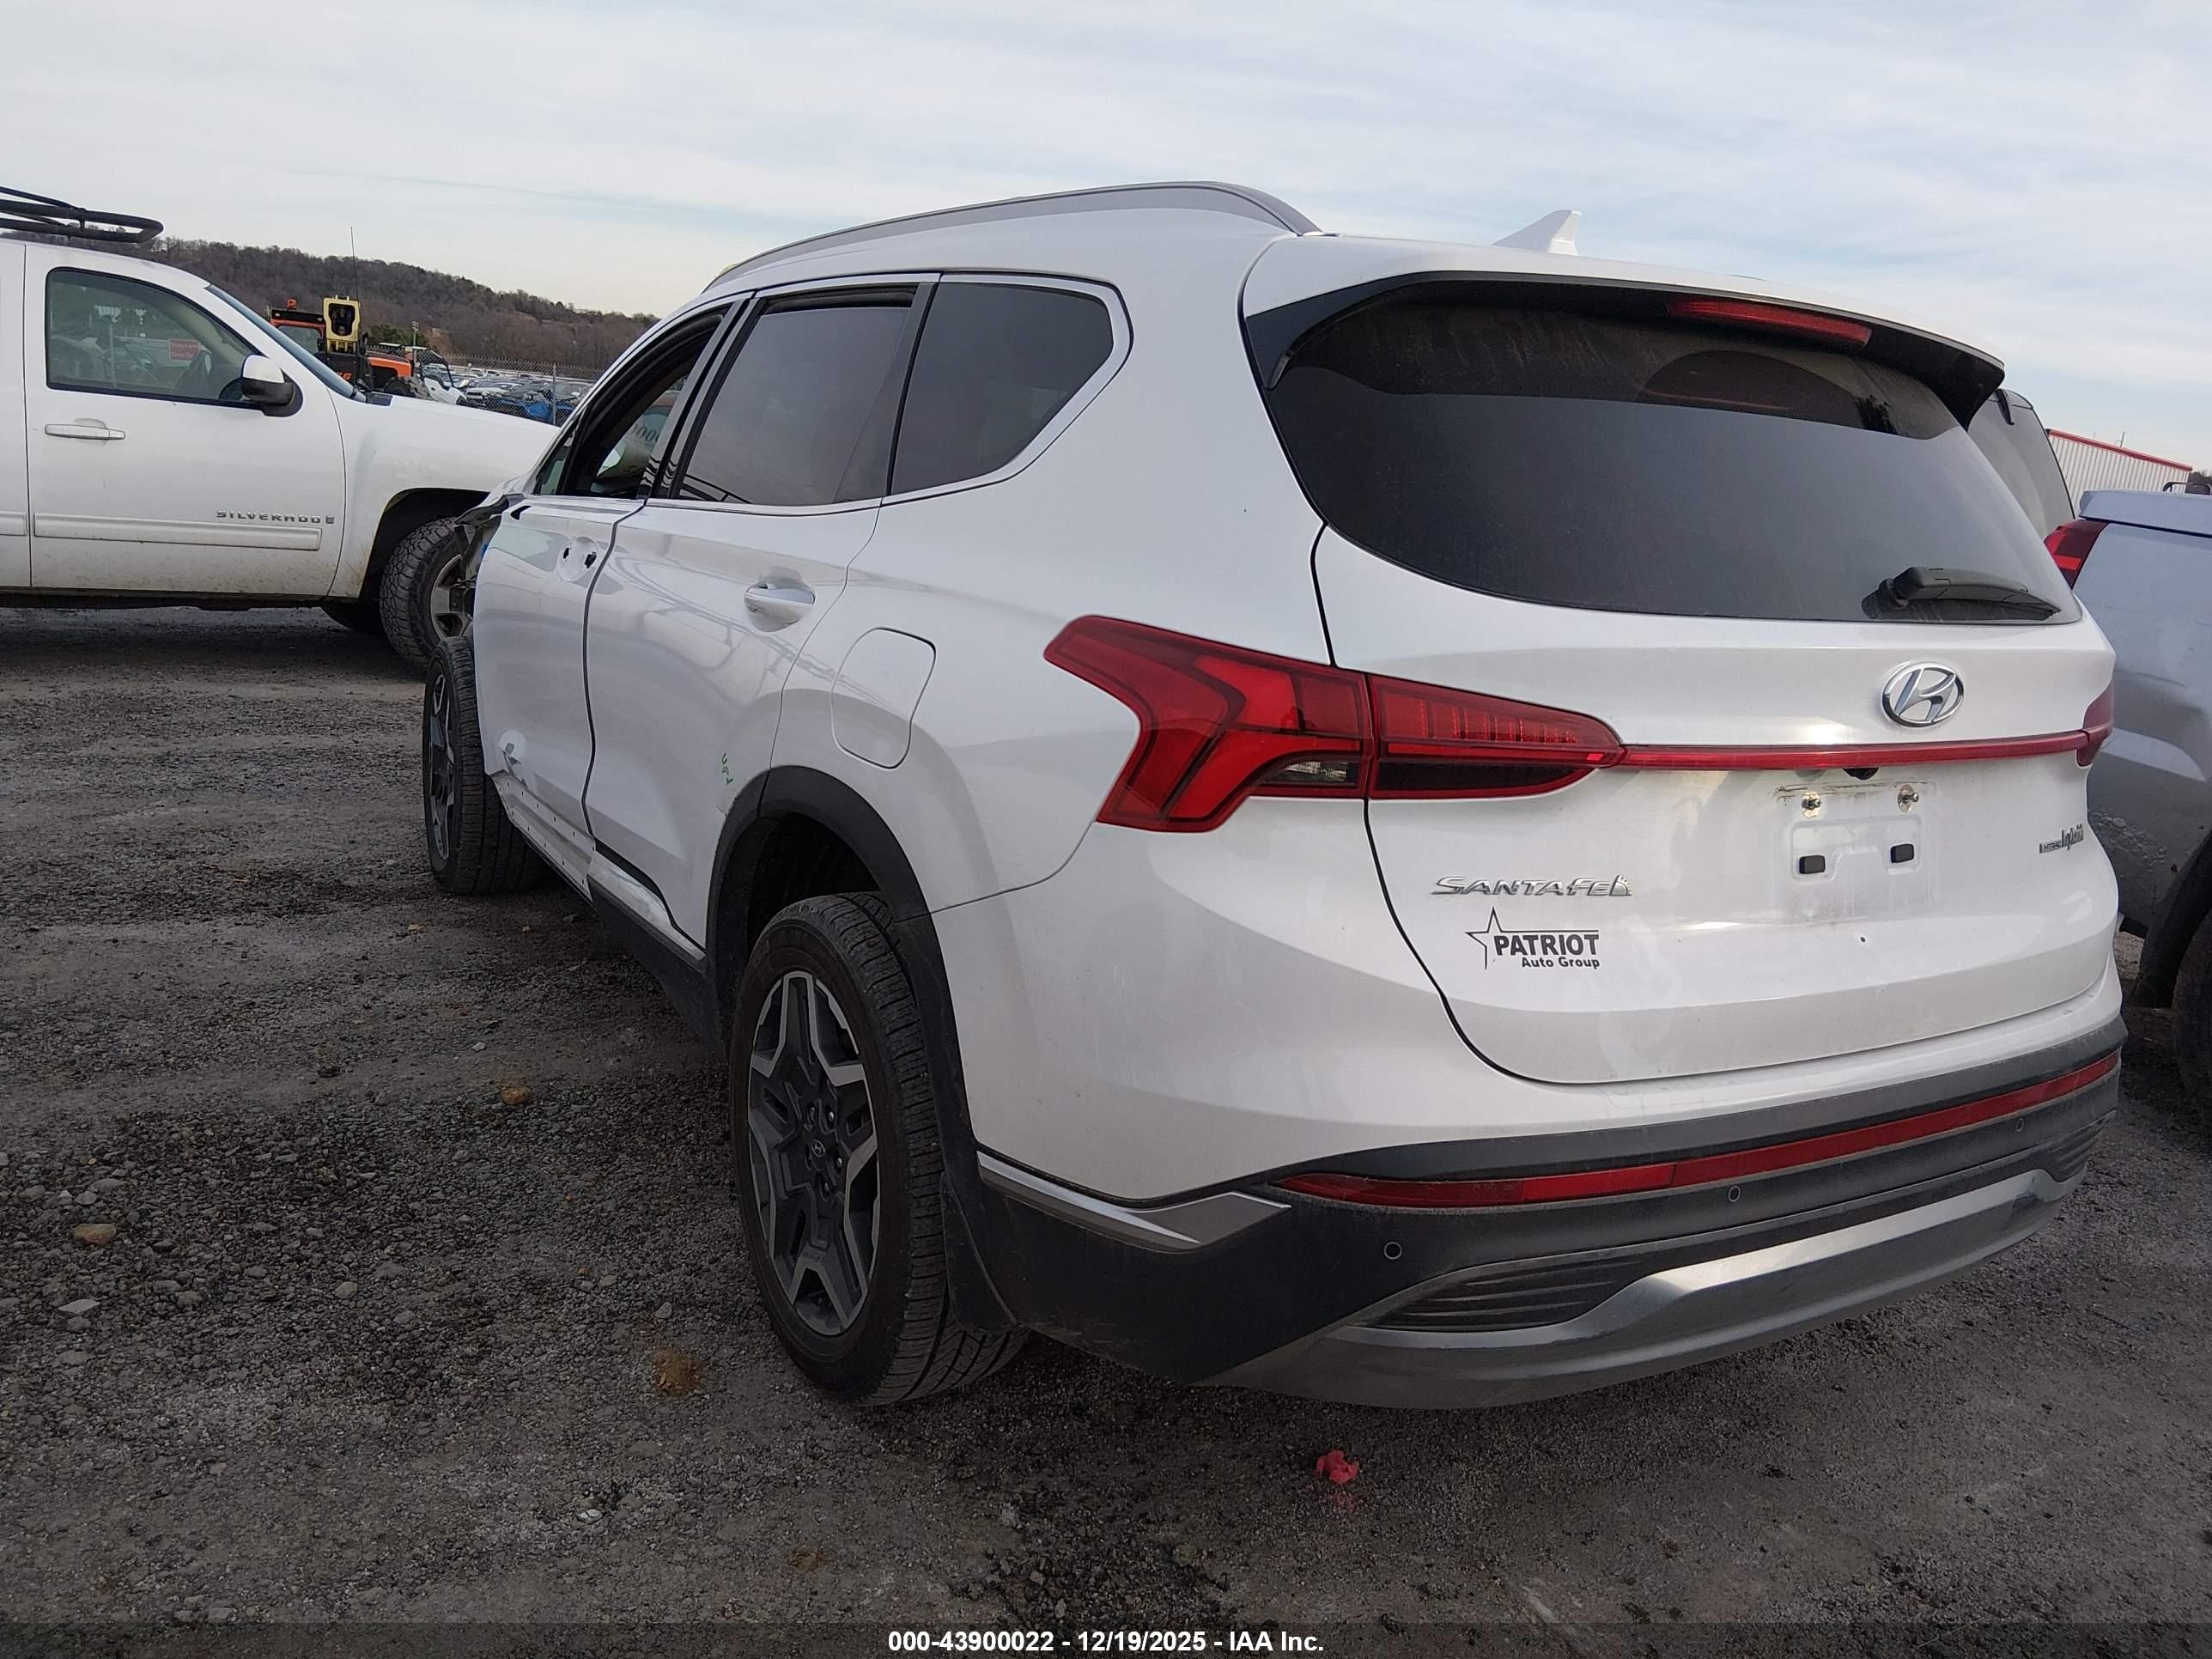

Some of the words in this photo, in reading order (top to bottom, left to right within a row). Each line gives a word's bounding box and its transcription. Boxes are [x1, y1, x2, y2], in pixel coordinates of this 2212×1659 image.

[216, 510, 321, 524] SILVERADO
[1493, 933, 1599, 957] PATRIOT
[1522, 957, 1554, 968] Auto
[1559, 957, 1600, 970] Group
